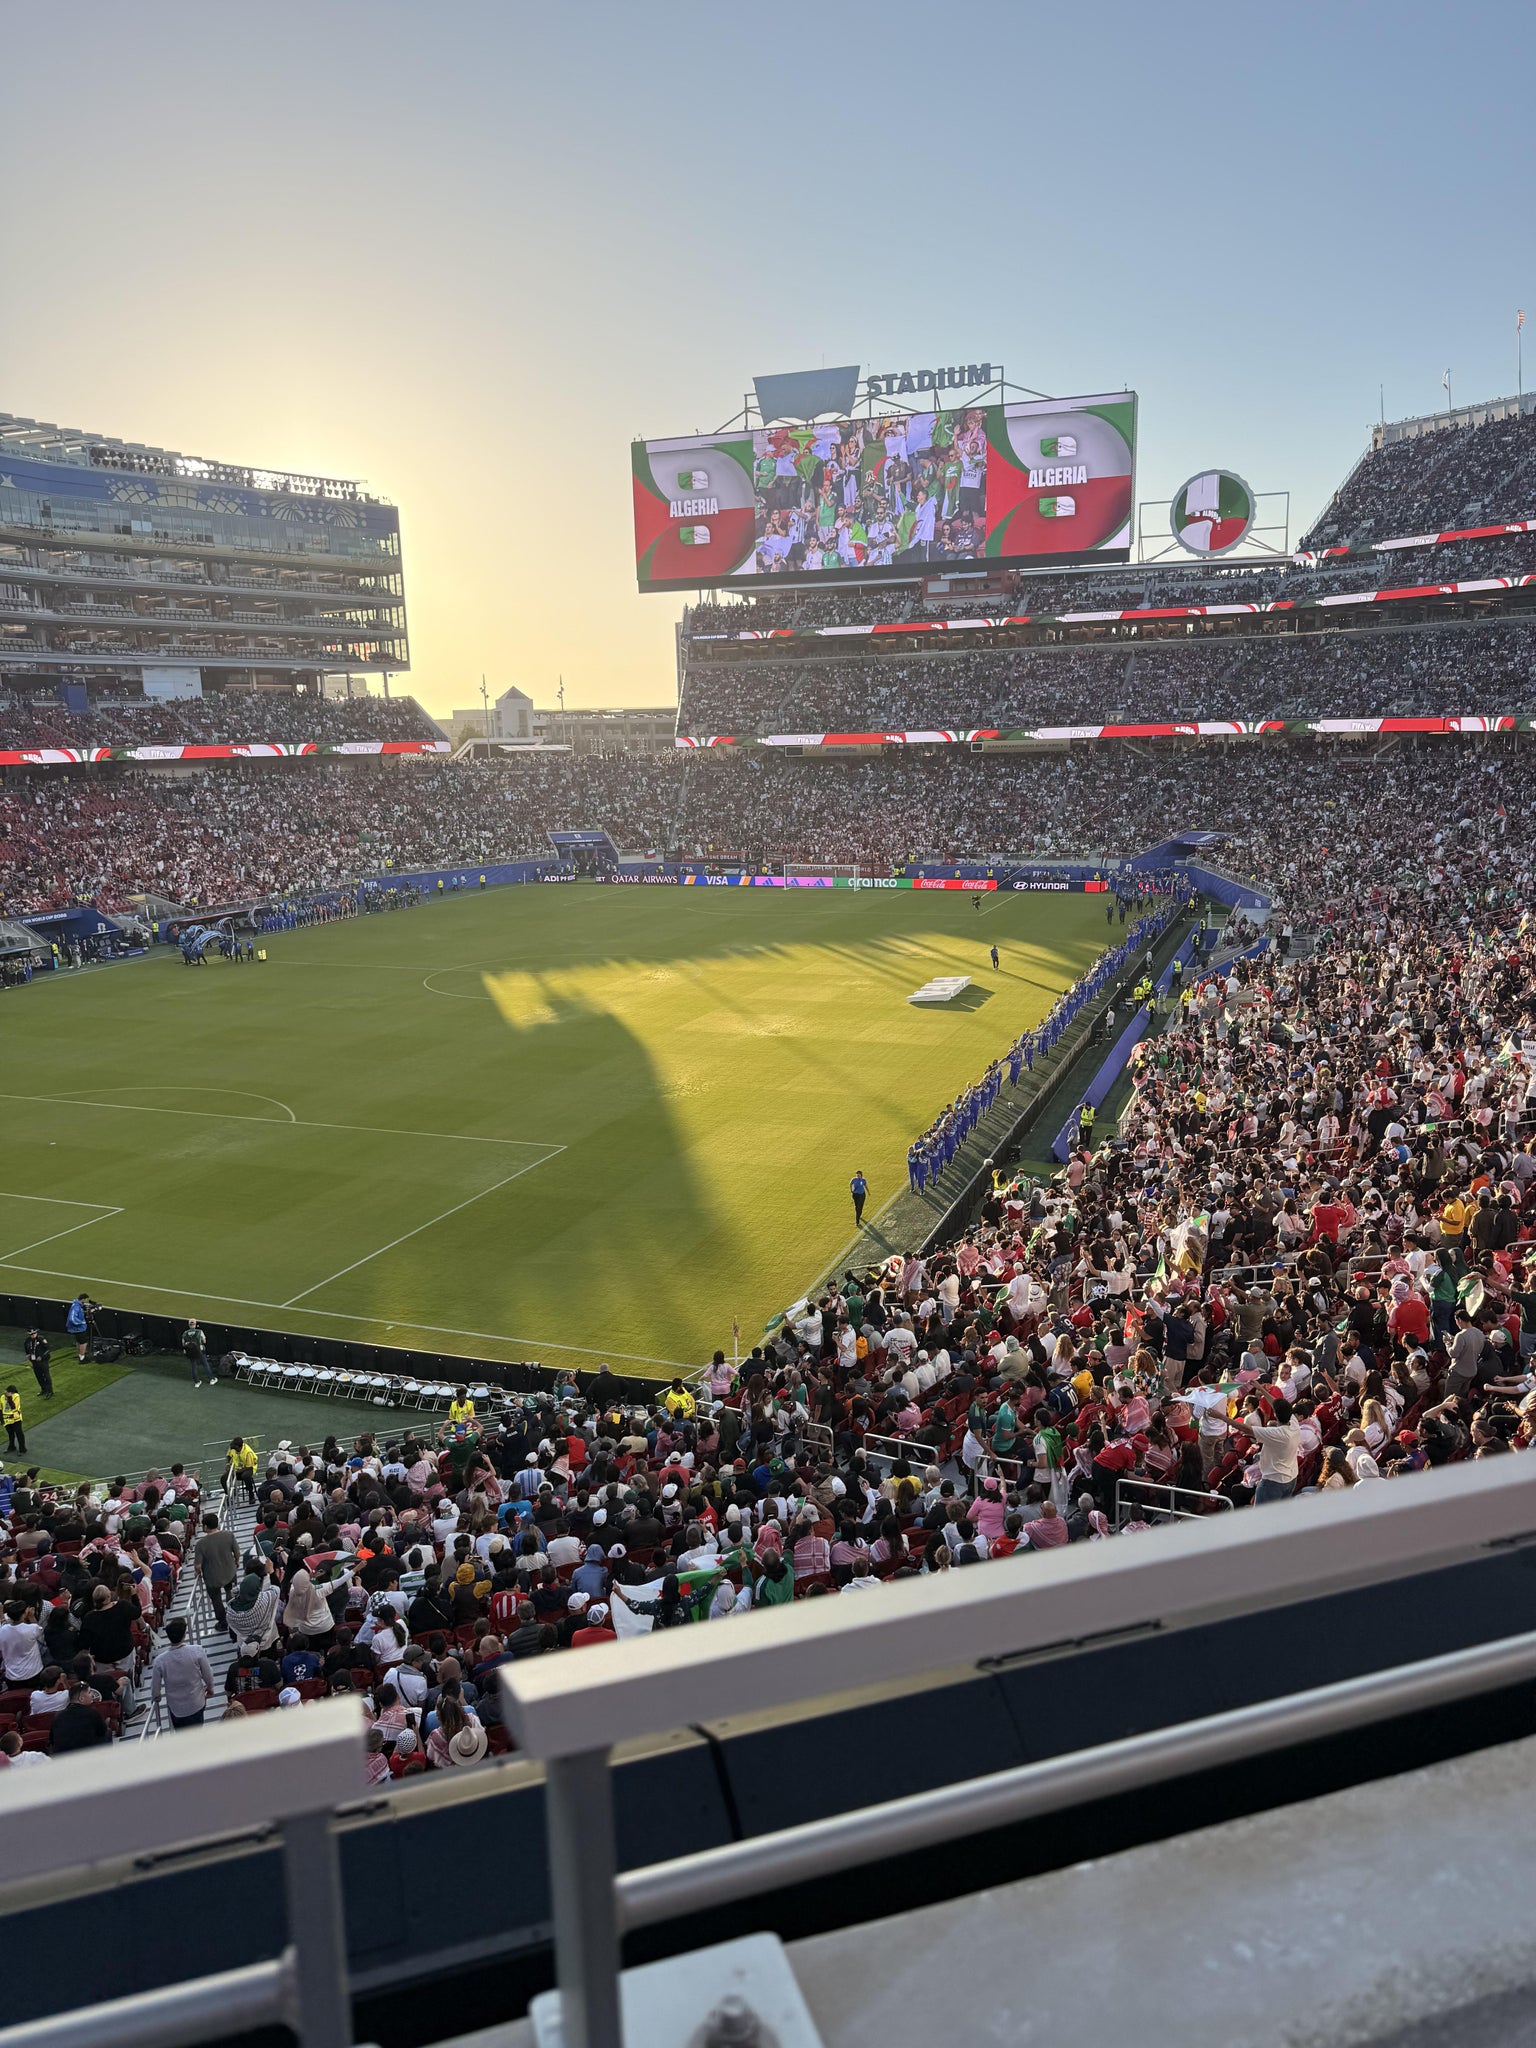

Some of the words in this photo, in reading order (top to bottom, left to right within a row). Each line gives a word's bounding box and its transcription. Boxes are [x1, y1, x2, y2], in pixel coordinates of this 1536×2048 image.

[867, 363, 991, 398] STADIUM
[1028, 465, 1087, 488] ALGERIA
[670, 498, 719, 517] ALGERIA
[611, 875, 639, 884] QATAR
[642, 875, 678, 884] AIRWAYS
[705, 876, 729, 885] VISA
[1030, 882, 1069, 890] HYUNDAI
[41, 1491, 59, 1502] 24
